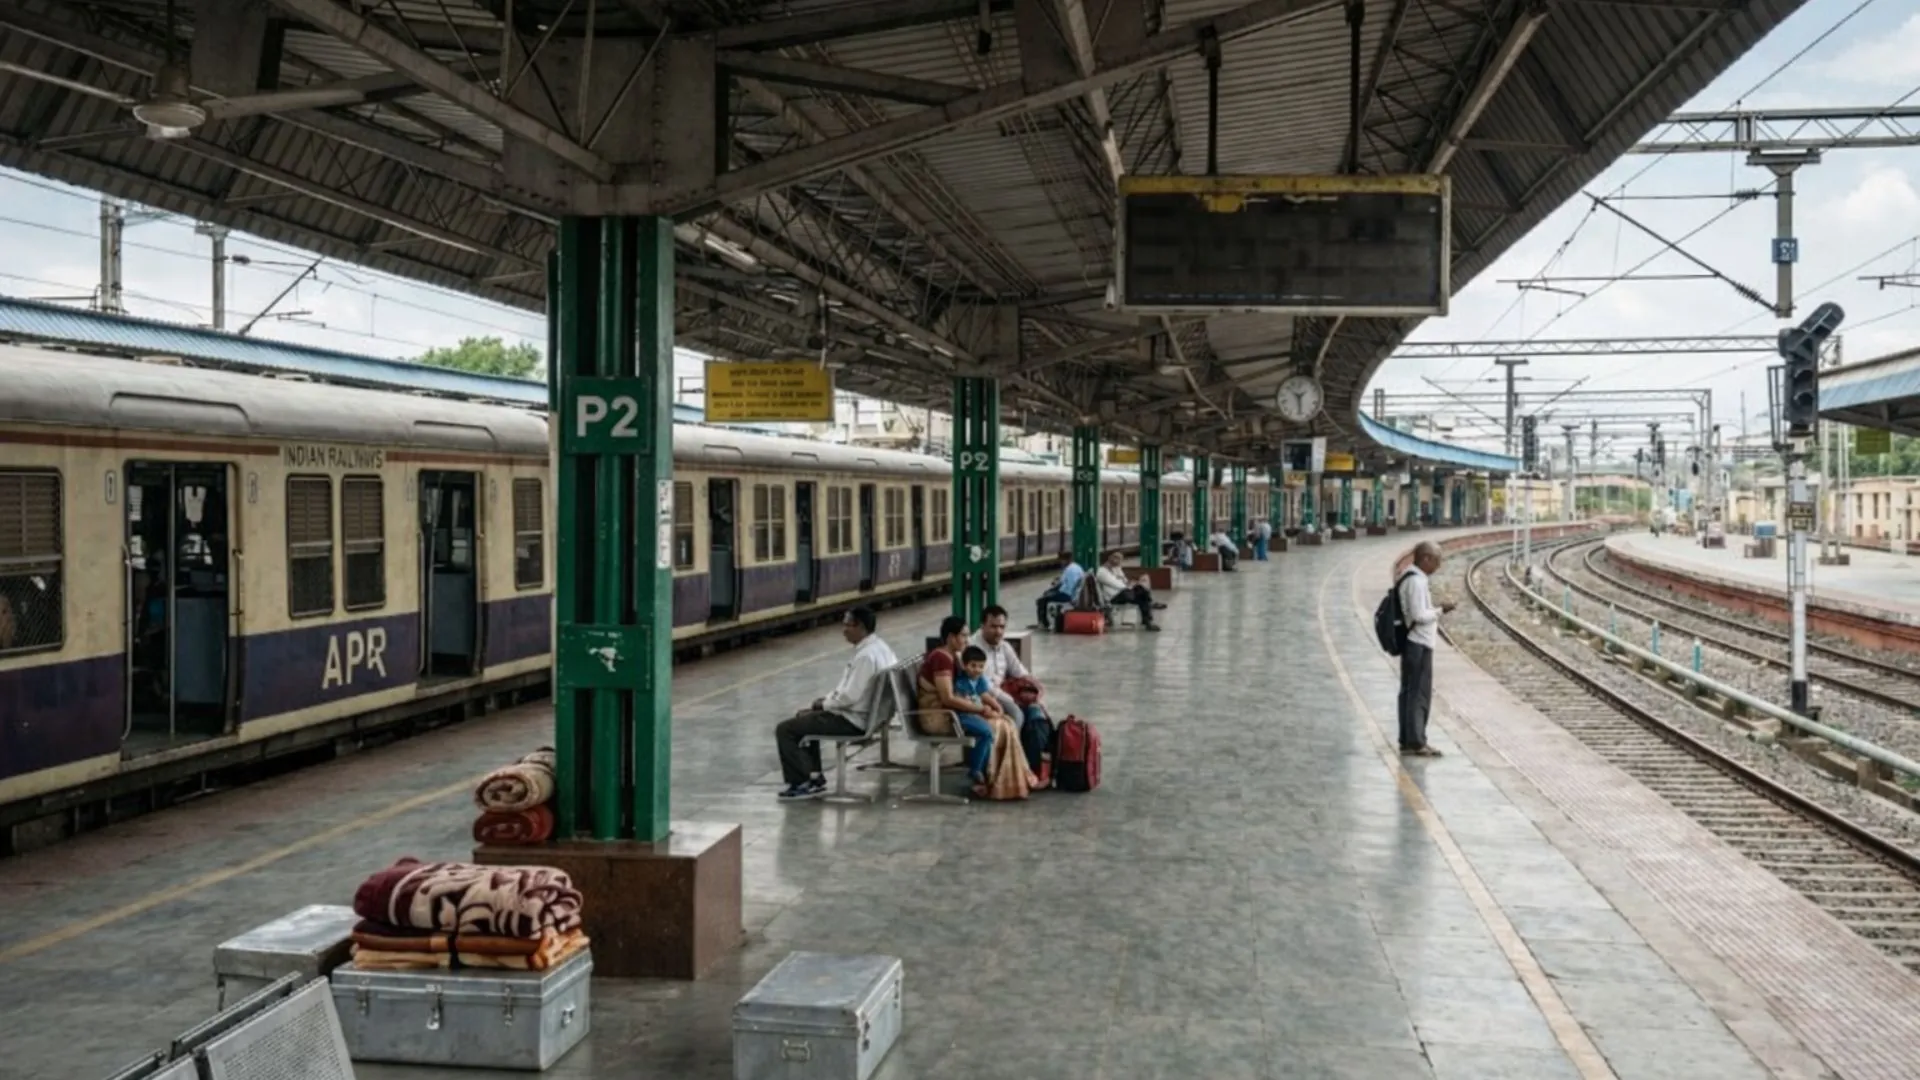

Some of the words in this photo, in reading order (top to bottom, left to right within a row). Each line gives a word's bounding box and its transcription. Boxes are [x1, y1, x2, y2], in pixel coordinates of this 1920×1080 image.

[576, 395, 638, 437] P2
[960, 451, 989, 470] P2
[322, 626, 387, 689] APR
